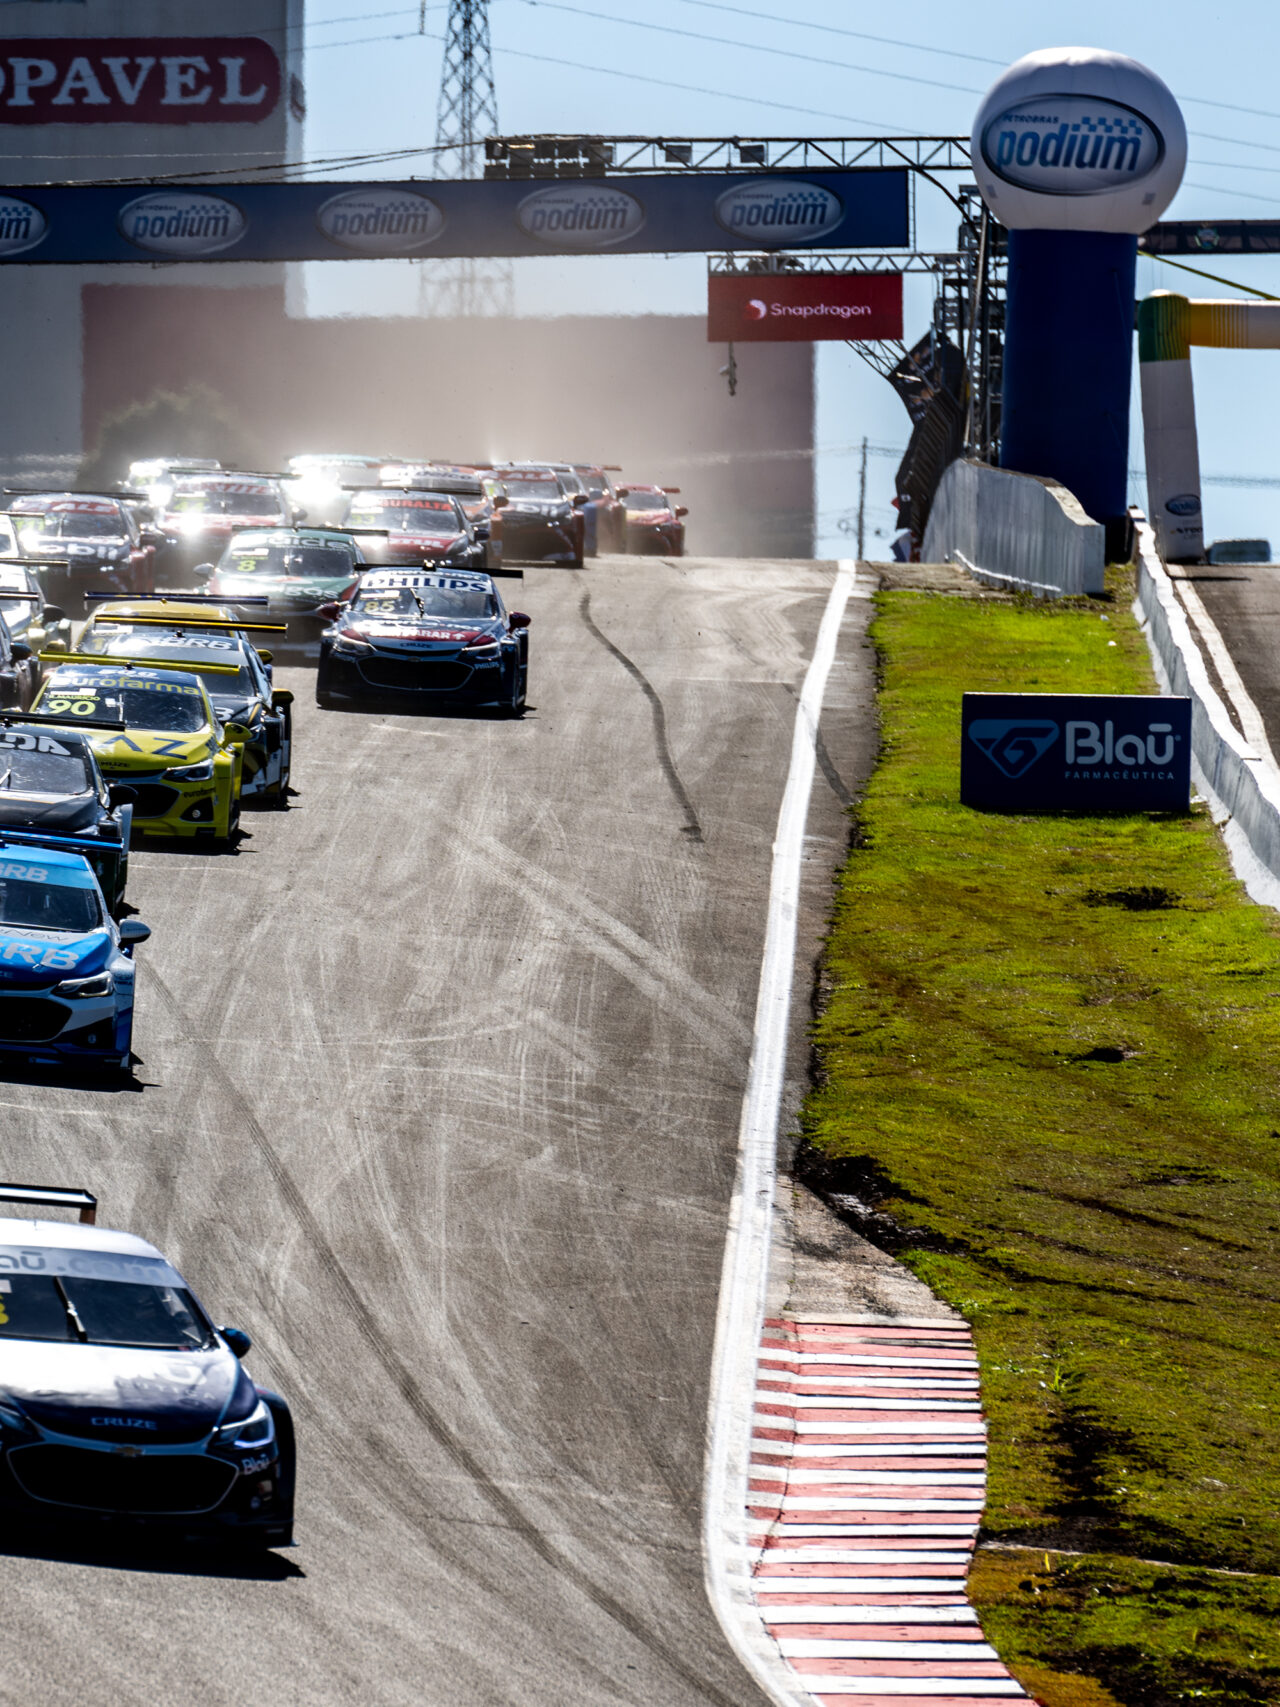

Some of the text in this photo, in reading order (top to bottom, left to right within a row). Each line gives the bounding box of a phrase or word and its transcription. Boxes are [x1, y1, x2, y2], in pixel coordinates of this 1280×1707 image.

[1001, 114, 1059, 124] PETROBRAS
[997, 123, 1143, 172] podium
[531, 203, 628, 231] podium
[730, 198, 828, 227] podium
[133, 210, 230, 238] podium
[332, 207, 429, 235] podium
[770, 303, 872, 319] Snapdragon
[236, 559, 257, 572] 8
[367, 577, 488, 594] PHILIPS
[363, 601, 396, 614] 85
[47, 700, 96, 716] 90
[1064, 770, 1175, 781] FARMACÊUTICA
[90, 1415, 158, 1431] CRUZE
